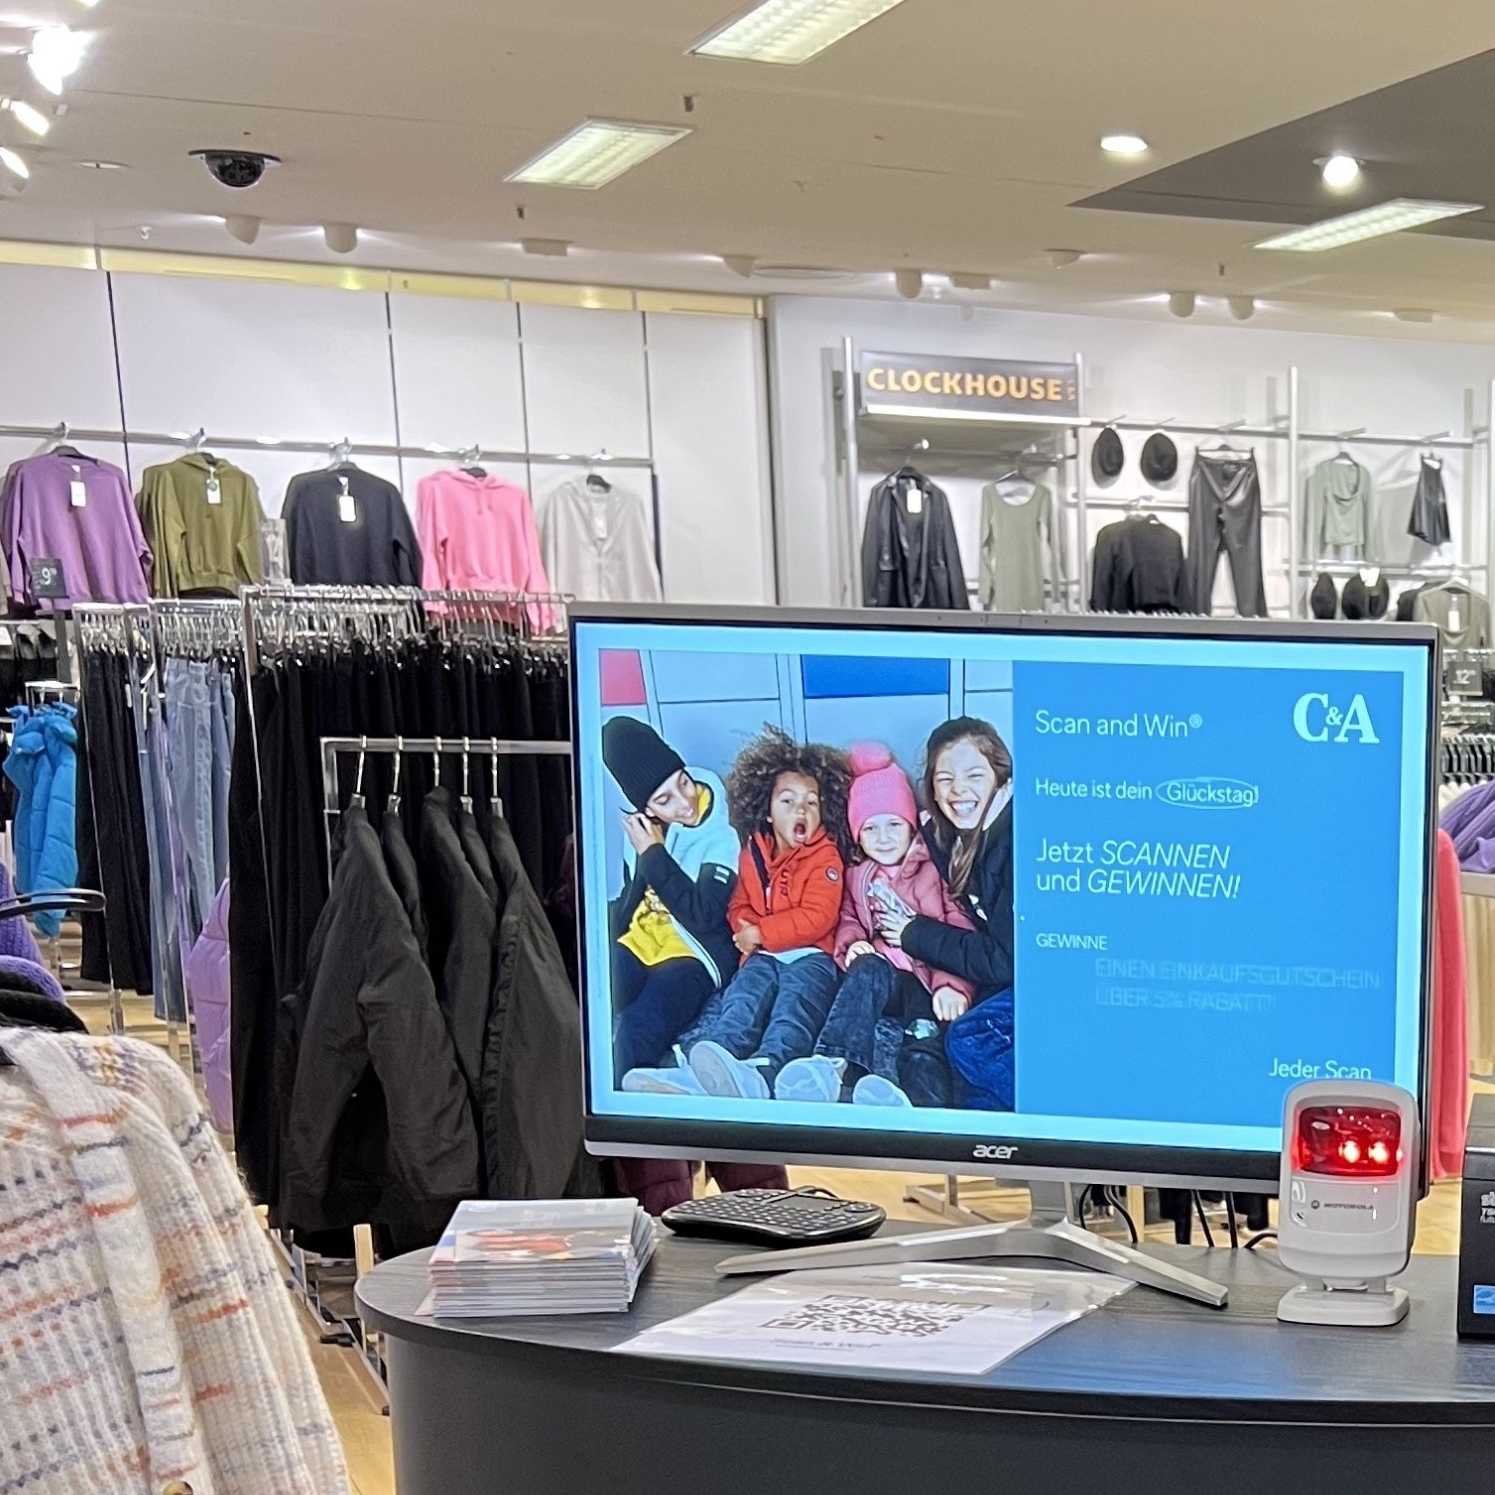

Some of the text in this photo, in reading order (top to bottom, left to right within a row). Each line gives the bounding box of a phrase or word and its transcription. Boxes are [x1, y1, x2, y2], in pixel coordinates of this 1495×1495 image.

[867, 367, 1063, 401] CLOCKHOUSE
[1035, 709, 1091, 735] Scan
[1096, 713, 1138, 737] and
[1292, 692, 1380, 744] C&A
[1035, 778, 1088, 798] Heute
[1091, 779, 1112, 798] ist
[1115, 780, 1153, 800] dein
[1036, 838, 1231, 869] Jetzt SCANNEN
[1036, 867, 1241, 899] und GEWINNEN!
[1035, 932, 1108, 950] GEWINNE
[1095, 957, 1381, 990] EINEN EINKAUFSGUTSCHEIN
[1268, 1057, 1372, 1080] Jeder Scan
[972, 1144, 1019, 1160] acer
[1324, 1203, 1374, 1211] MOTOROLA
